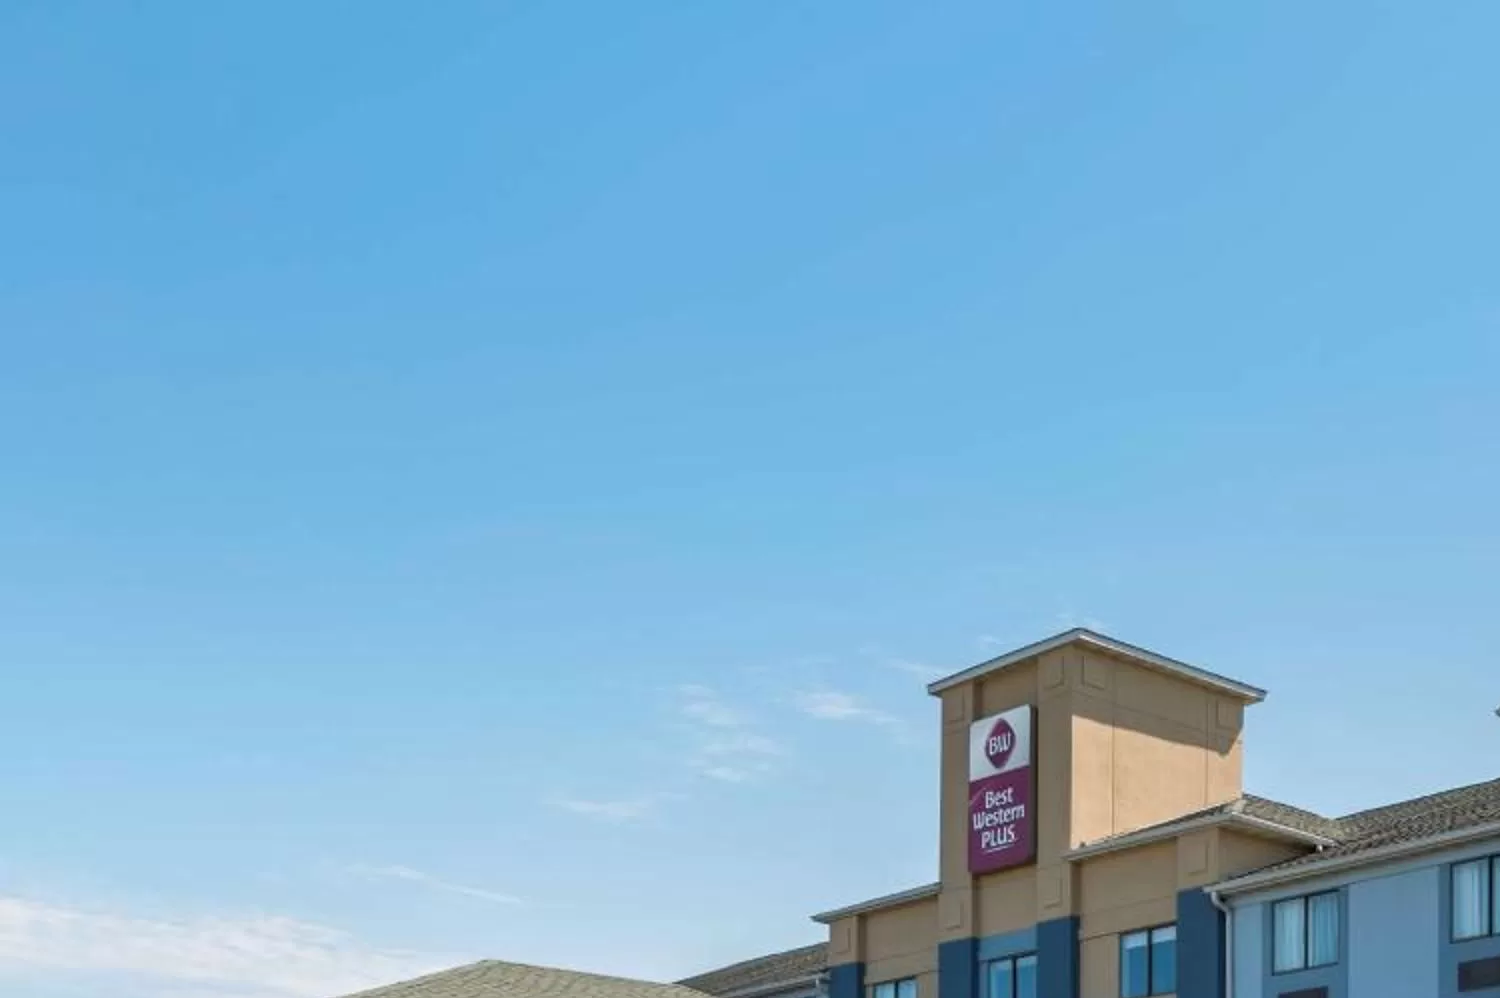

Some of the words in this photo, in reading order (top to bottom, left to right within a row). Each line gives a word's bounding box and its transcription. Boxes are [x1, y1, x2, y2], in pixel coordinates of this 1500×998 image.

[988, 732, 1012, 756] BW
[985, 787, 1014, 809] Best
[973, 804, 1025, 830] Western
[981, 826, 1016, 849] PLUS
